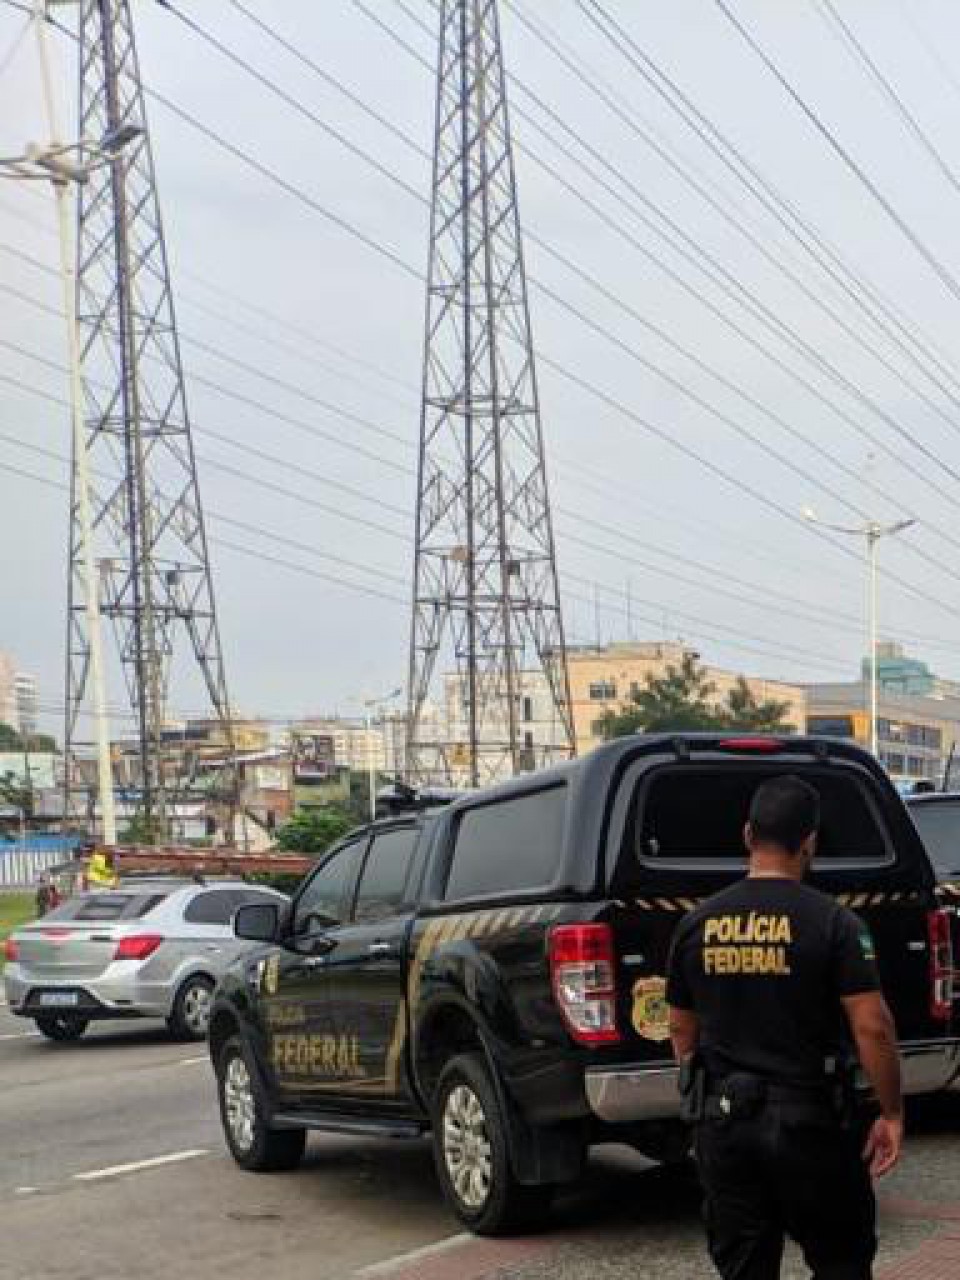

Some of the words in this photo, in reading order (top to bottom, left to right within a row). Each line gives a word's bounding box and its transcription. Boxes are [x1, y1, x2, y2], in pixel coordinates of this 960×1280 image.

[704, 911, 791, 943] POLÍCIA
[704, 946, 791, 976] FEDERAL
[272, 1034, 366, 1076] FEDERAL
